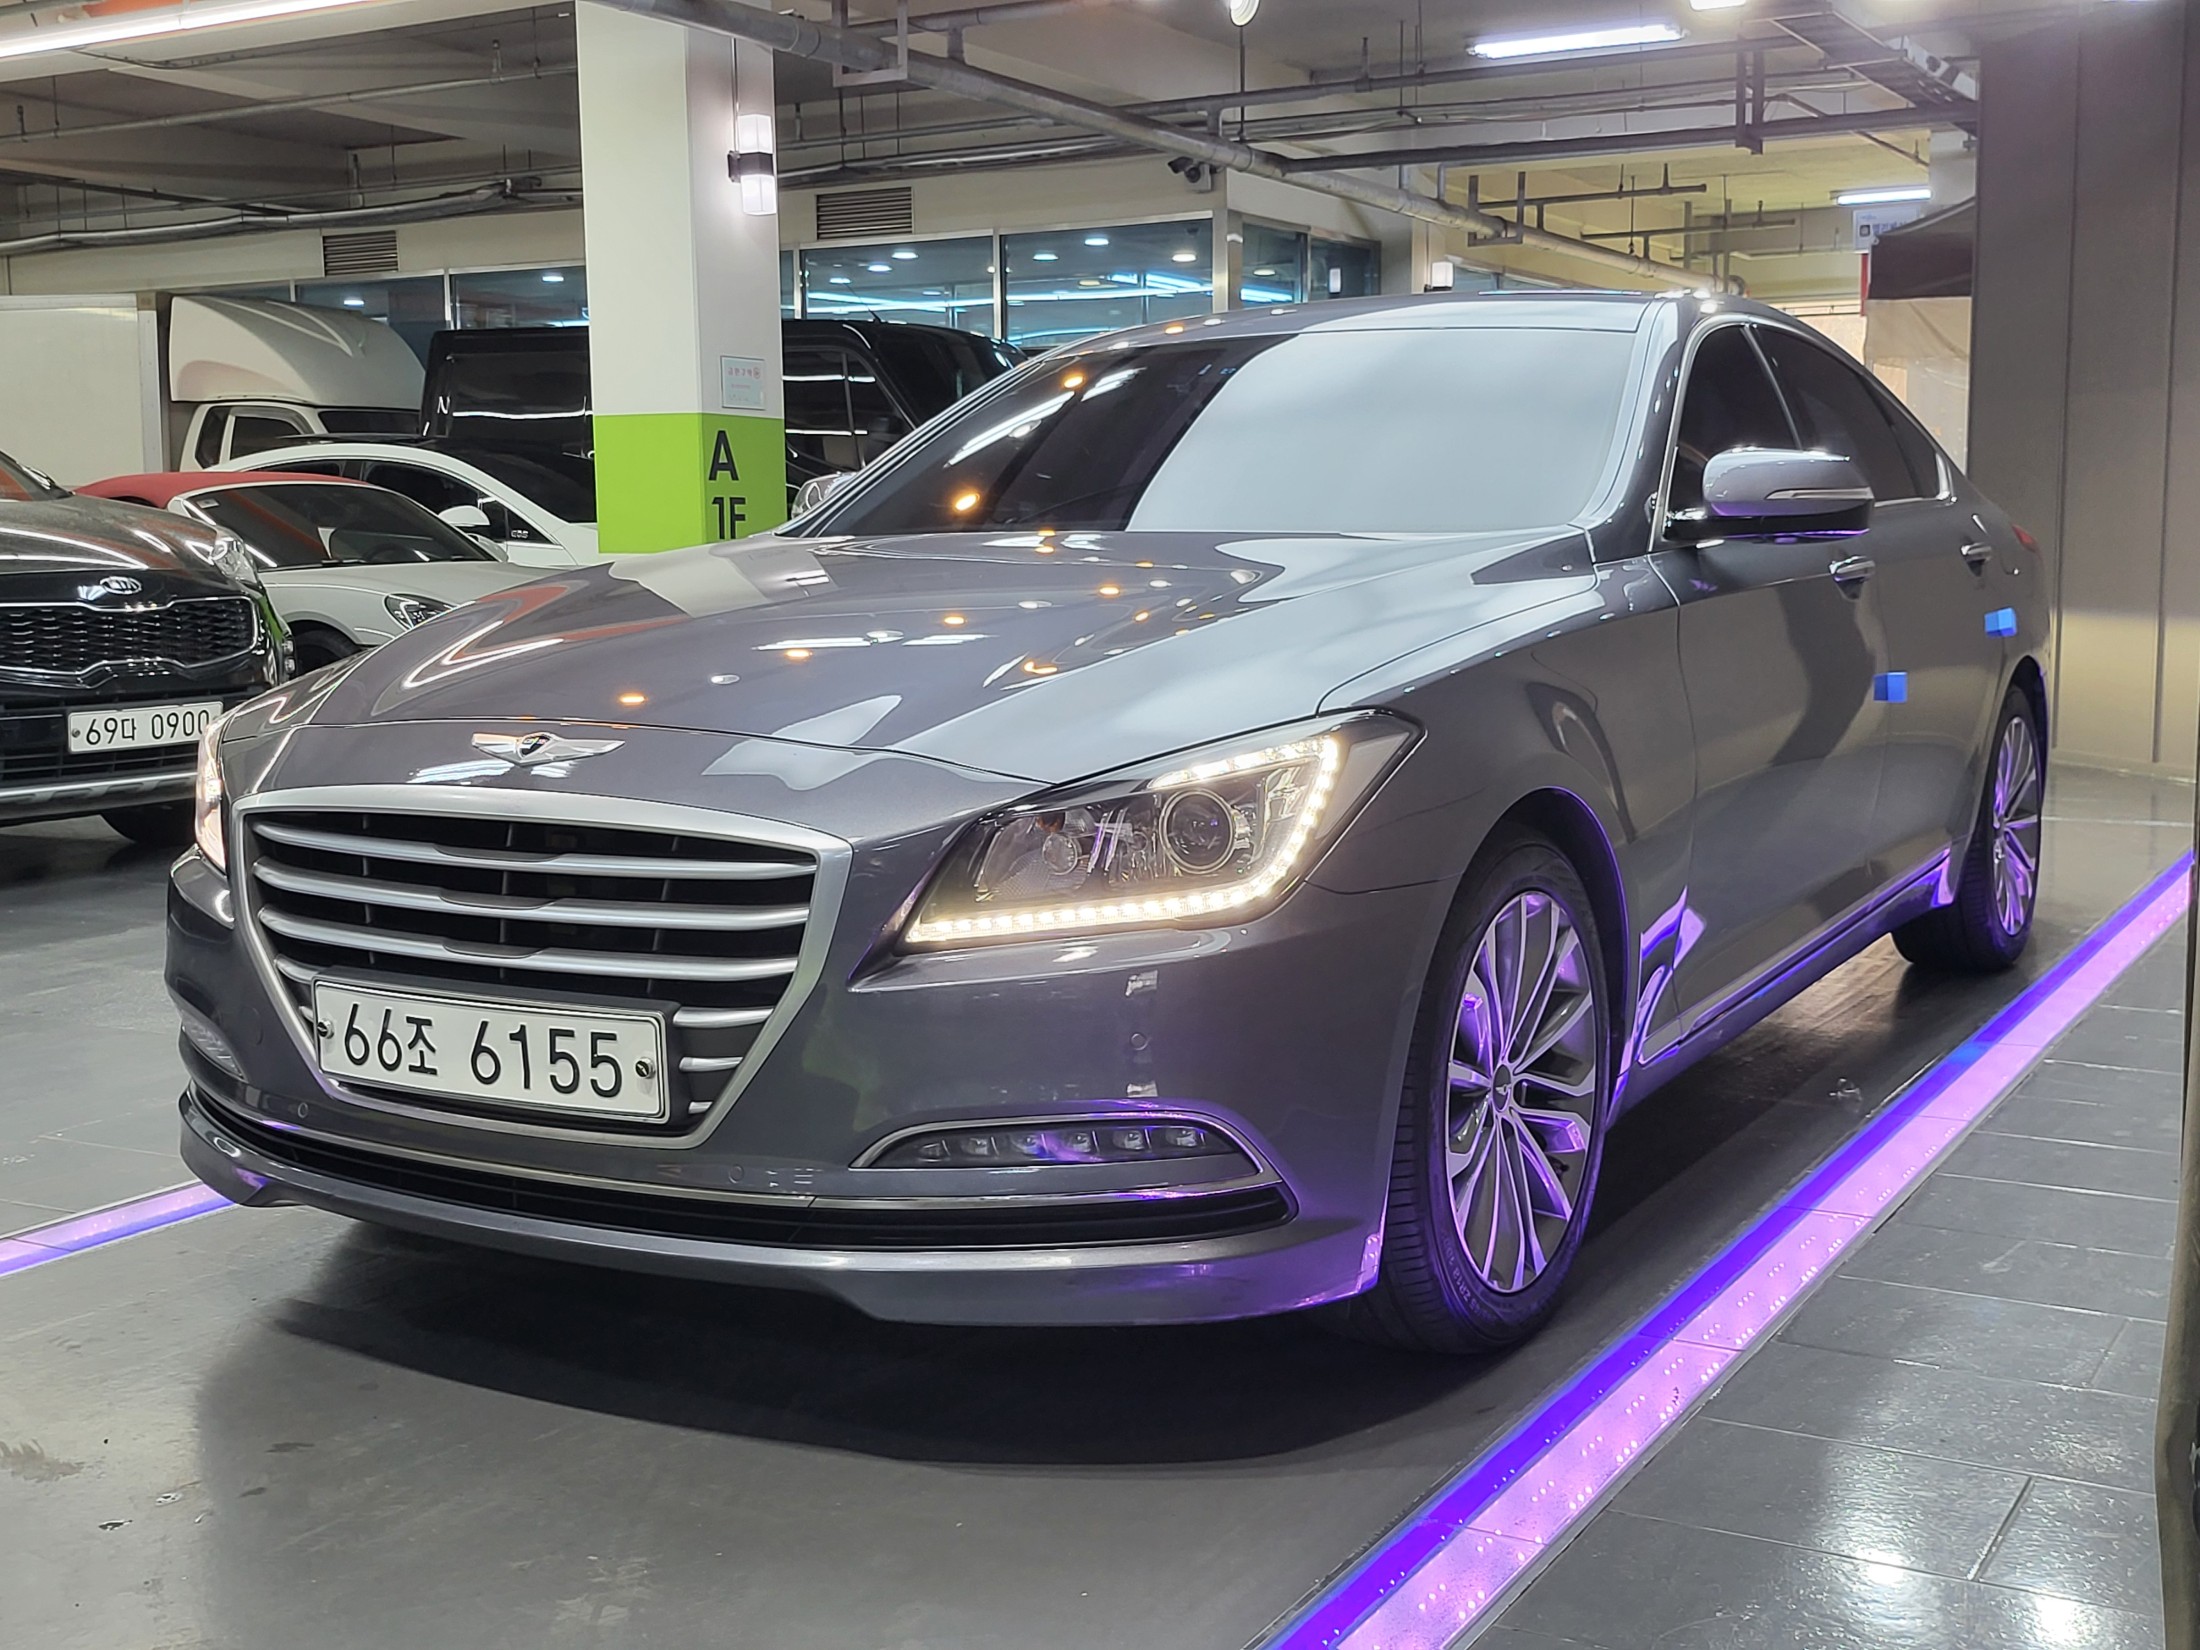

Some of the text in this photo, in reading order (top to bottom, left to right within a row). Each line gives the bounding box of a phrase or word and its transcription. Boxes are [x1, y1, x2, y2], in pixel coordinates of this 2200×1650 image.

[708, 430, 739, 481] A
[712, 497, 746, 540] 1F
[86, 709, 210, 745] 69다 0900
[344, 1003, 623, 1098] 66조 6155
